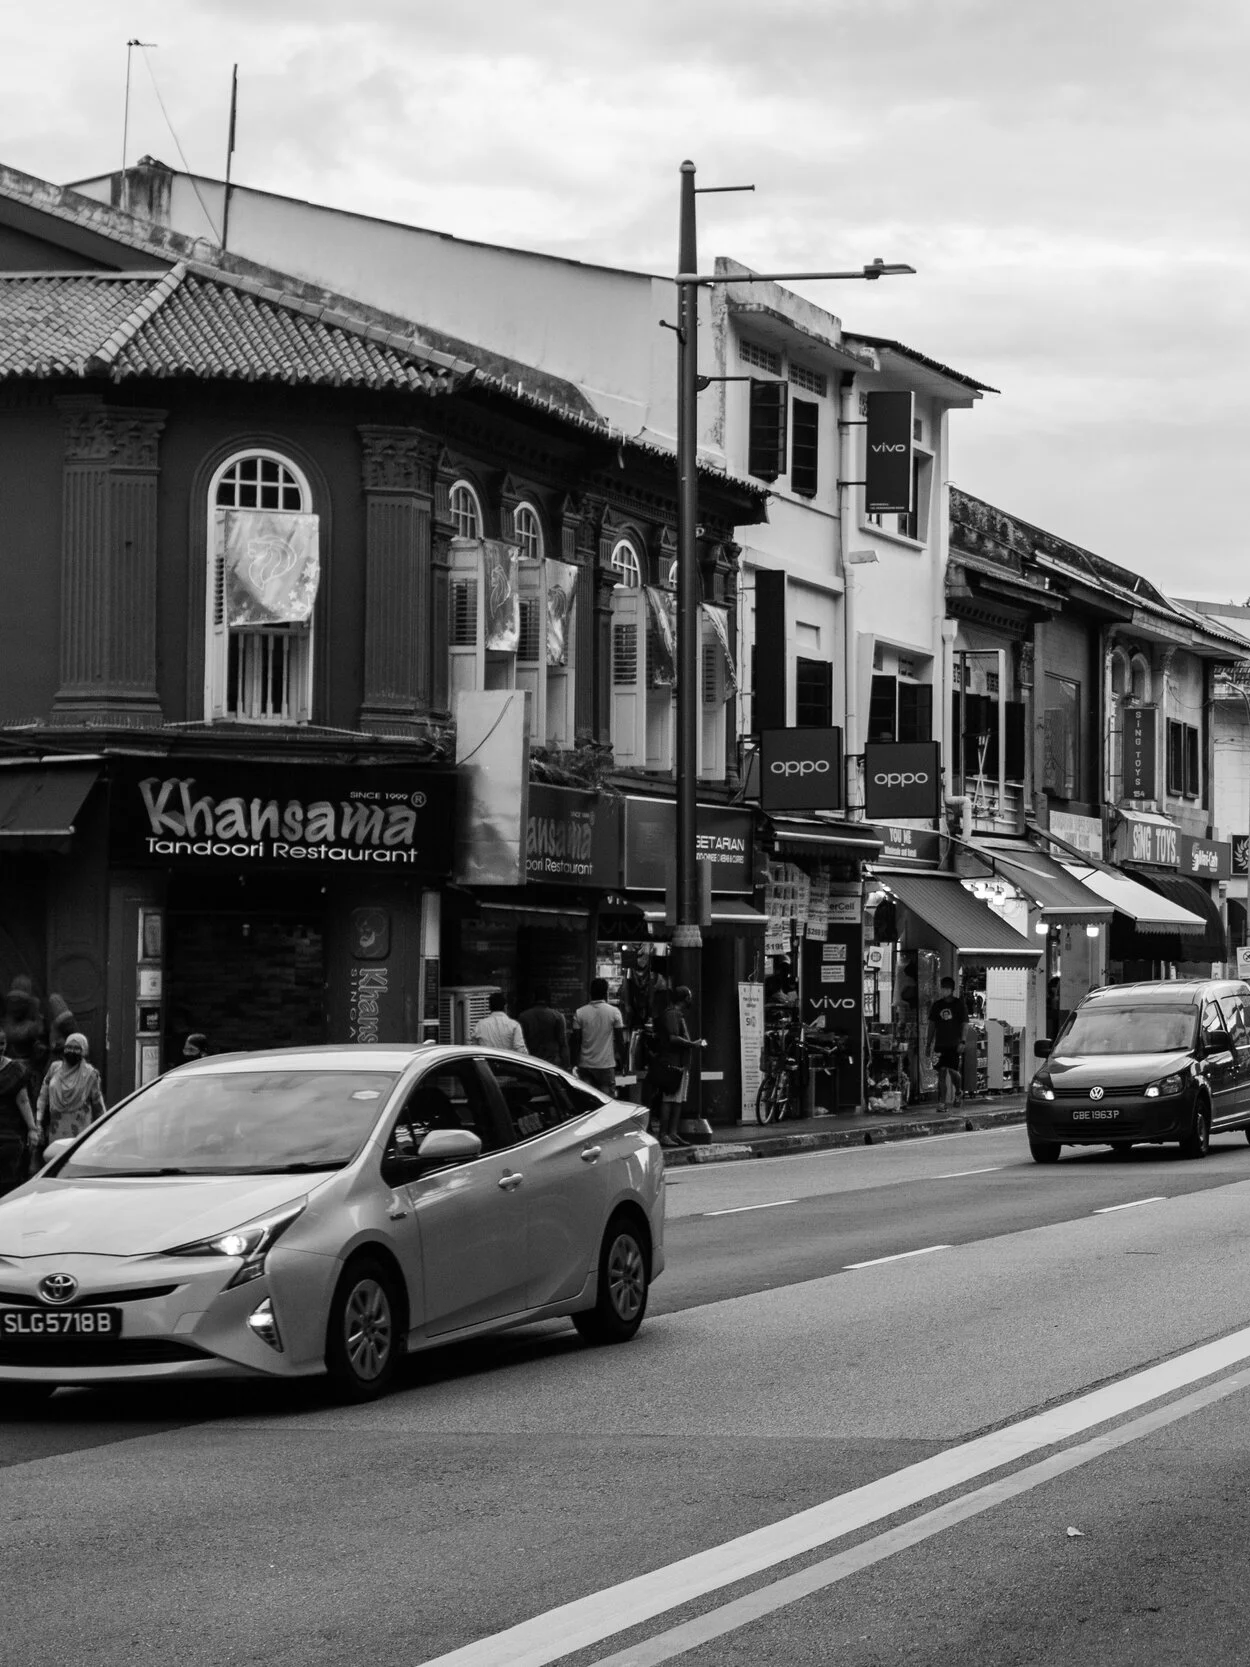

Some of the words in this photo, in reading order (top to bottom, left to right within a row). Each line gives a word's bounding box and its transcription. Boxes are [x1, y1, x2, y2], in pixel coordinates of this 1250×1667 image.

[872, 442, 905, 452] vivo
[770, 760, 830, 777] oppo
[874, 772, 928, 788] oppo
[350, 791, 380, 799] SINCE
[385, 792, 408, 800] 1999
[138, 777, 417, 846] Khansama
[527, 815, 592, 861] ansama
[1133, 824, 1152, 861] SING
[145, 836, 263, 857] Tandoori
[273, 842, 418, 863] Restaurant
[526, 857, 543, 871] oori
[545, 858, 594, 875] Restaurant
[810, 996, 855, 1009] vivo
[1073, 1110, 1120, 1120] GBE1963P
[4, 1313, 112, 1333] SLG5718B
